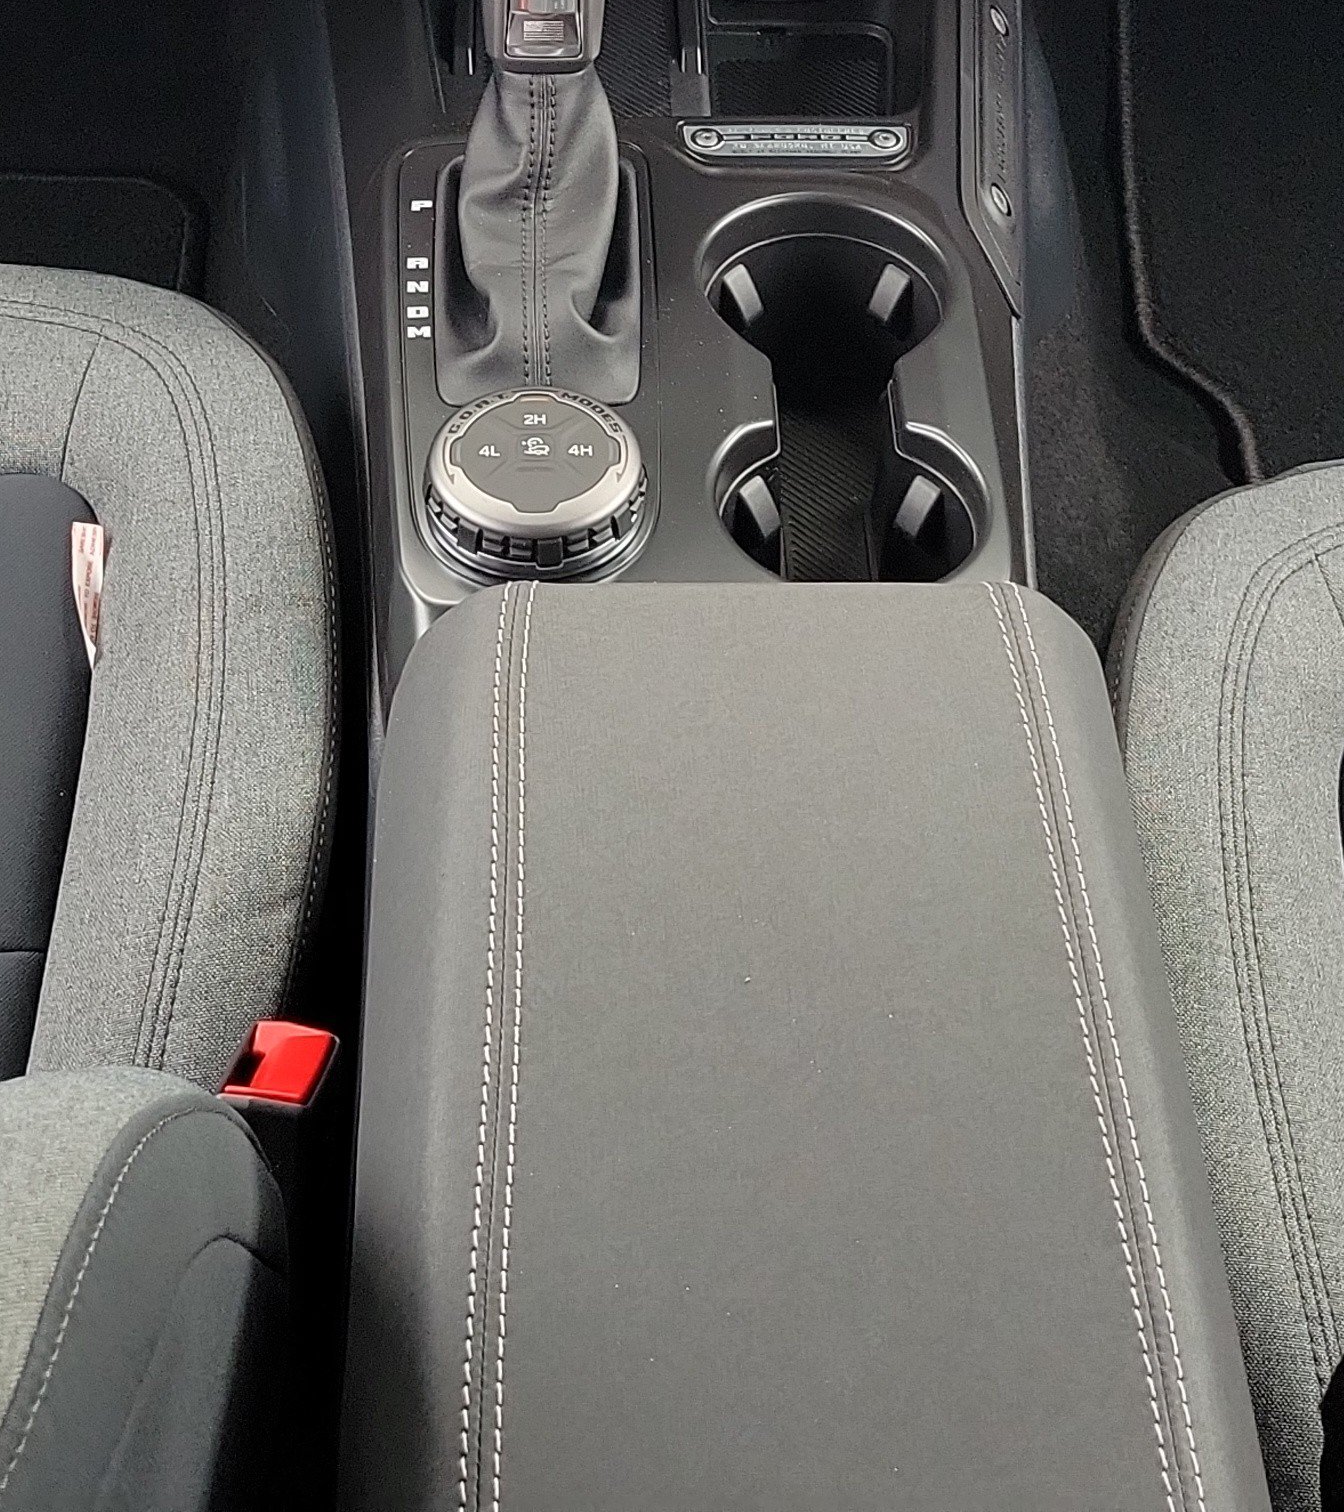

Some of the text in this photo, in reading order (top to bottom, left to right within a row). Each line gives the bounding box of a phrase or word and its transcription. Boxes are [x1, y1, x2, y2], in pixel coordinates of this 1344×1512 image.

[411, 200, 433, 211] P
[407, 281, 429, 293] N
[407, 326, 432, 338] M
[523, 413, 547, 426] 2H
[560, 391, 624, 435] MODES
[478, 444, 501, 457] 4L
[567, 444, 594, 457] 4H
